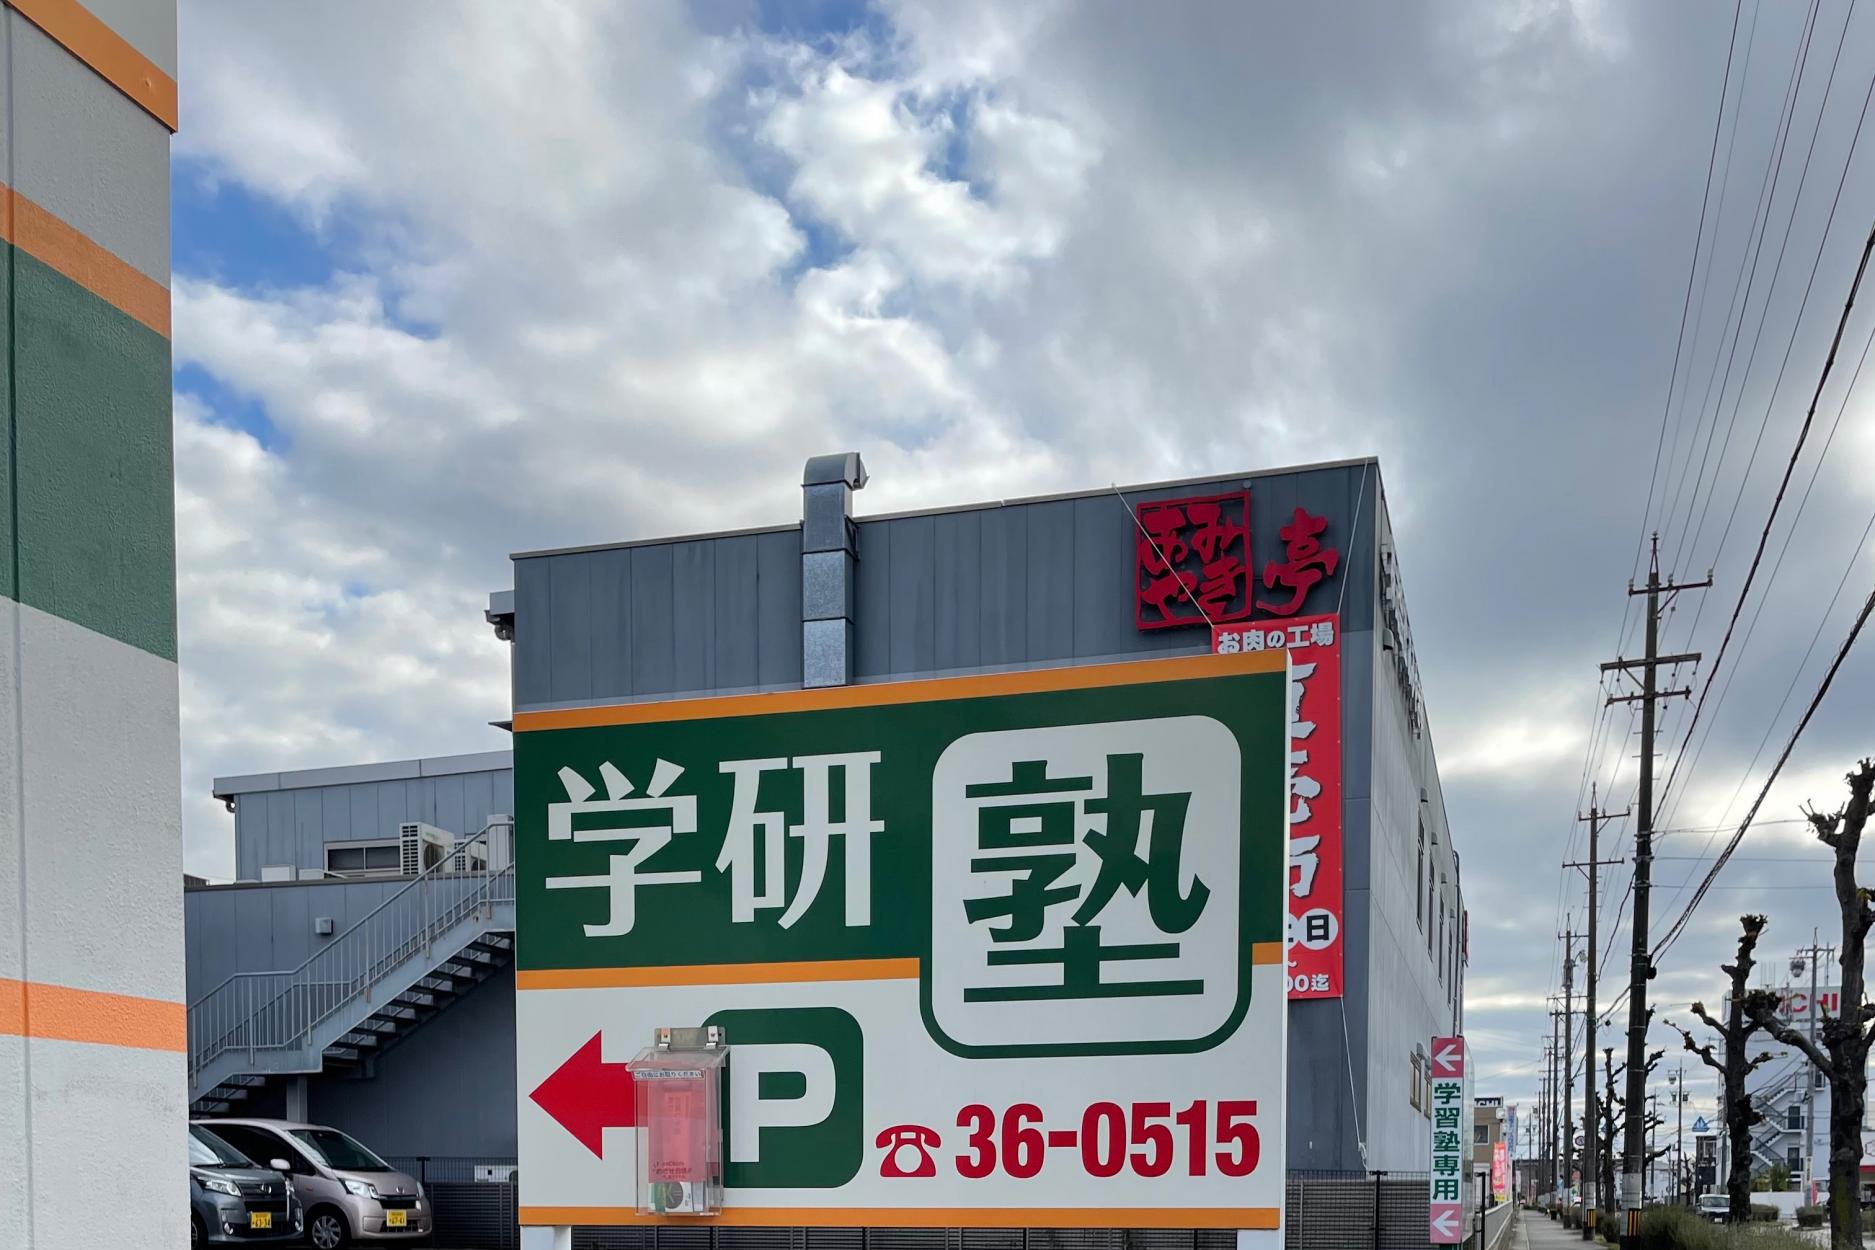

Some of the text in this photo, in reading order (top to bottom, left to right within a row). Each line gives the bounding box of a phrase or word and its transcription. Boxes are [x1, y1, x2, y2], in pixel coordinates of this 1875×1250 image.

[1217, 622, 1334, 653] お肉の工場
[730, 1042, 837, 1163] P
[954, 1100, 1260, 1179] 36-0515
[1432, 1082, 1461, 1201] 学習塾専用
